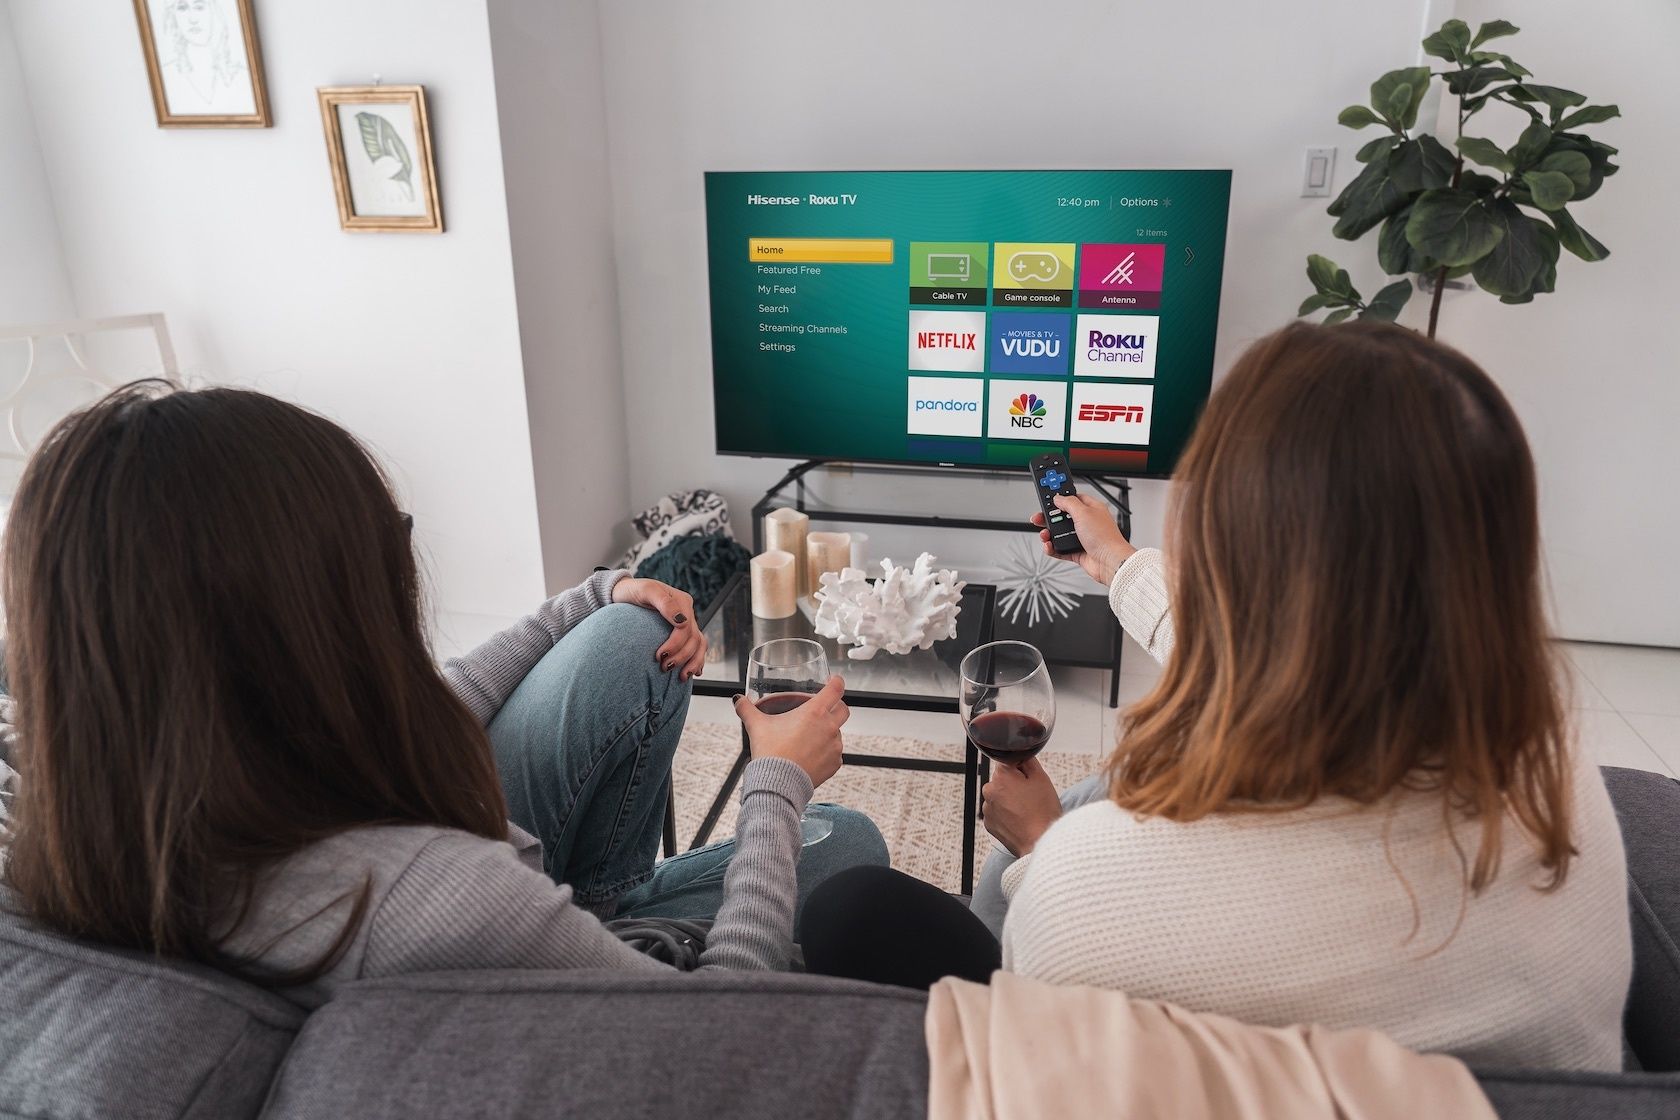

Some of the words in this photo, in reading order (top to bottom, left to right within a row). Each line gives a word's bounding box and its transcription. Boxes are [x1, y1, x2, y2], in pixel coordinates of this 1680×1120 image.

[747, 194, 800, 205] Hisense
[809, 194, 839, 205] Roku
[840, 194, 857, 205] TV
[1057, 197, 1082, 207] 12:40
[1084, 199, 1100, 208] pm
[1120, 197, 1159, 208] Options
[1136, 229, 1144, 237] 12
[1145, 229, 1168, 237] Items
[757, 246, 784, 254] Home
[757, 265, 798, 275] Featured
[800, 265, 821, 275] Free
[758, 285, 771, 295] My
[773, 285, 797, 294] Feed
[932, 292, 955, 300] Cable
[956, 292, 968, 300] TV
[1004, 293, 1028, 302] Game
[1029, 294, 1061, 302] console
[1101, 295, 1137, 304] Antenna
[758, 304, 789, 313] Search
[759, 323, 805, 334] Streaming
[807, 324, 848, 334] Channels
[1007, 330, 1036, 338] MOVIES
[1037, 330, 1043, 338] &
[918, 332, 976, 350] NETFLIX
[1088, 330, 1145, 350] Roku
[759, 342, 796, 353] Settings
[1001, 338, 1061, 358] VUDU
[1087, 348, 1144, 363] Channel
[915, 398, 977, 412] pandora
[1078, 404, 1144, 423] ESPN
[1011, 416, 1044, 429] NBC
